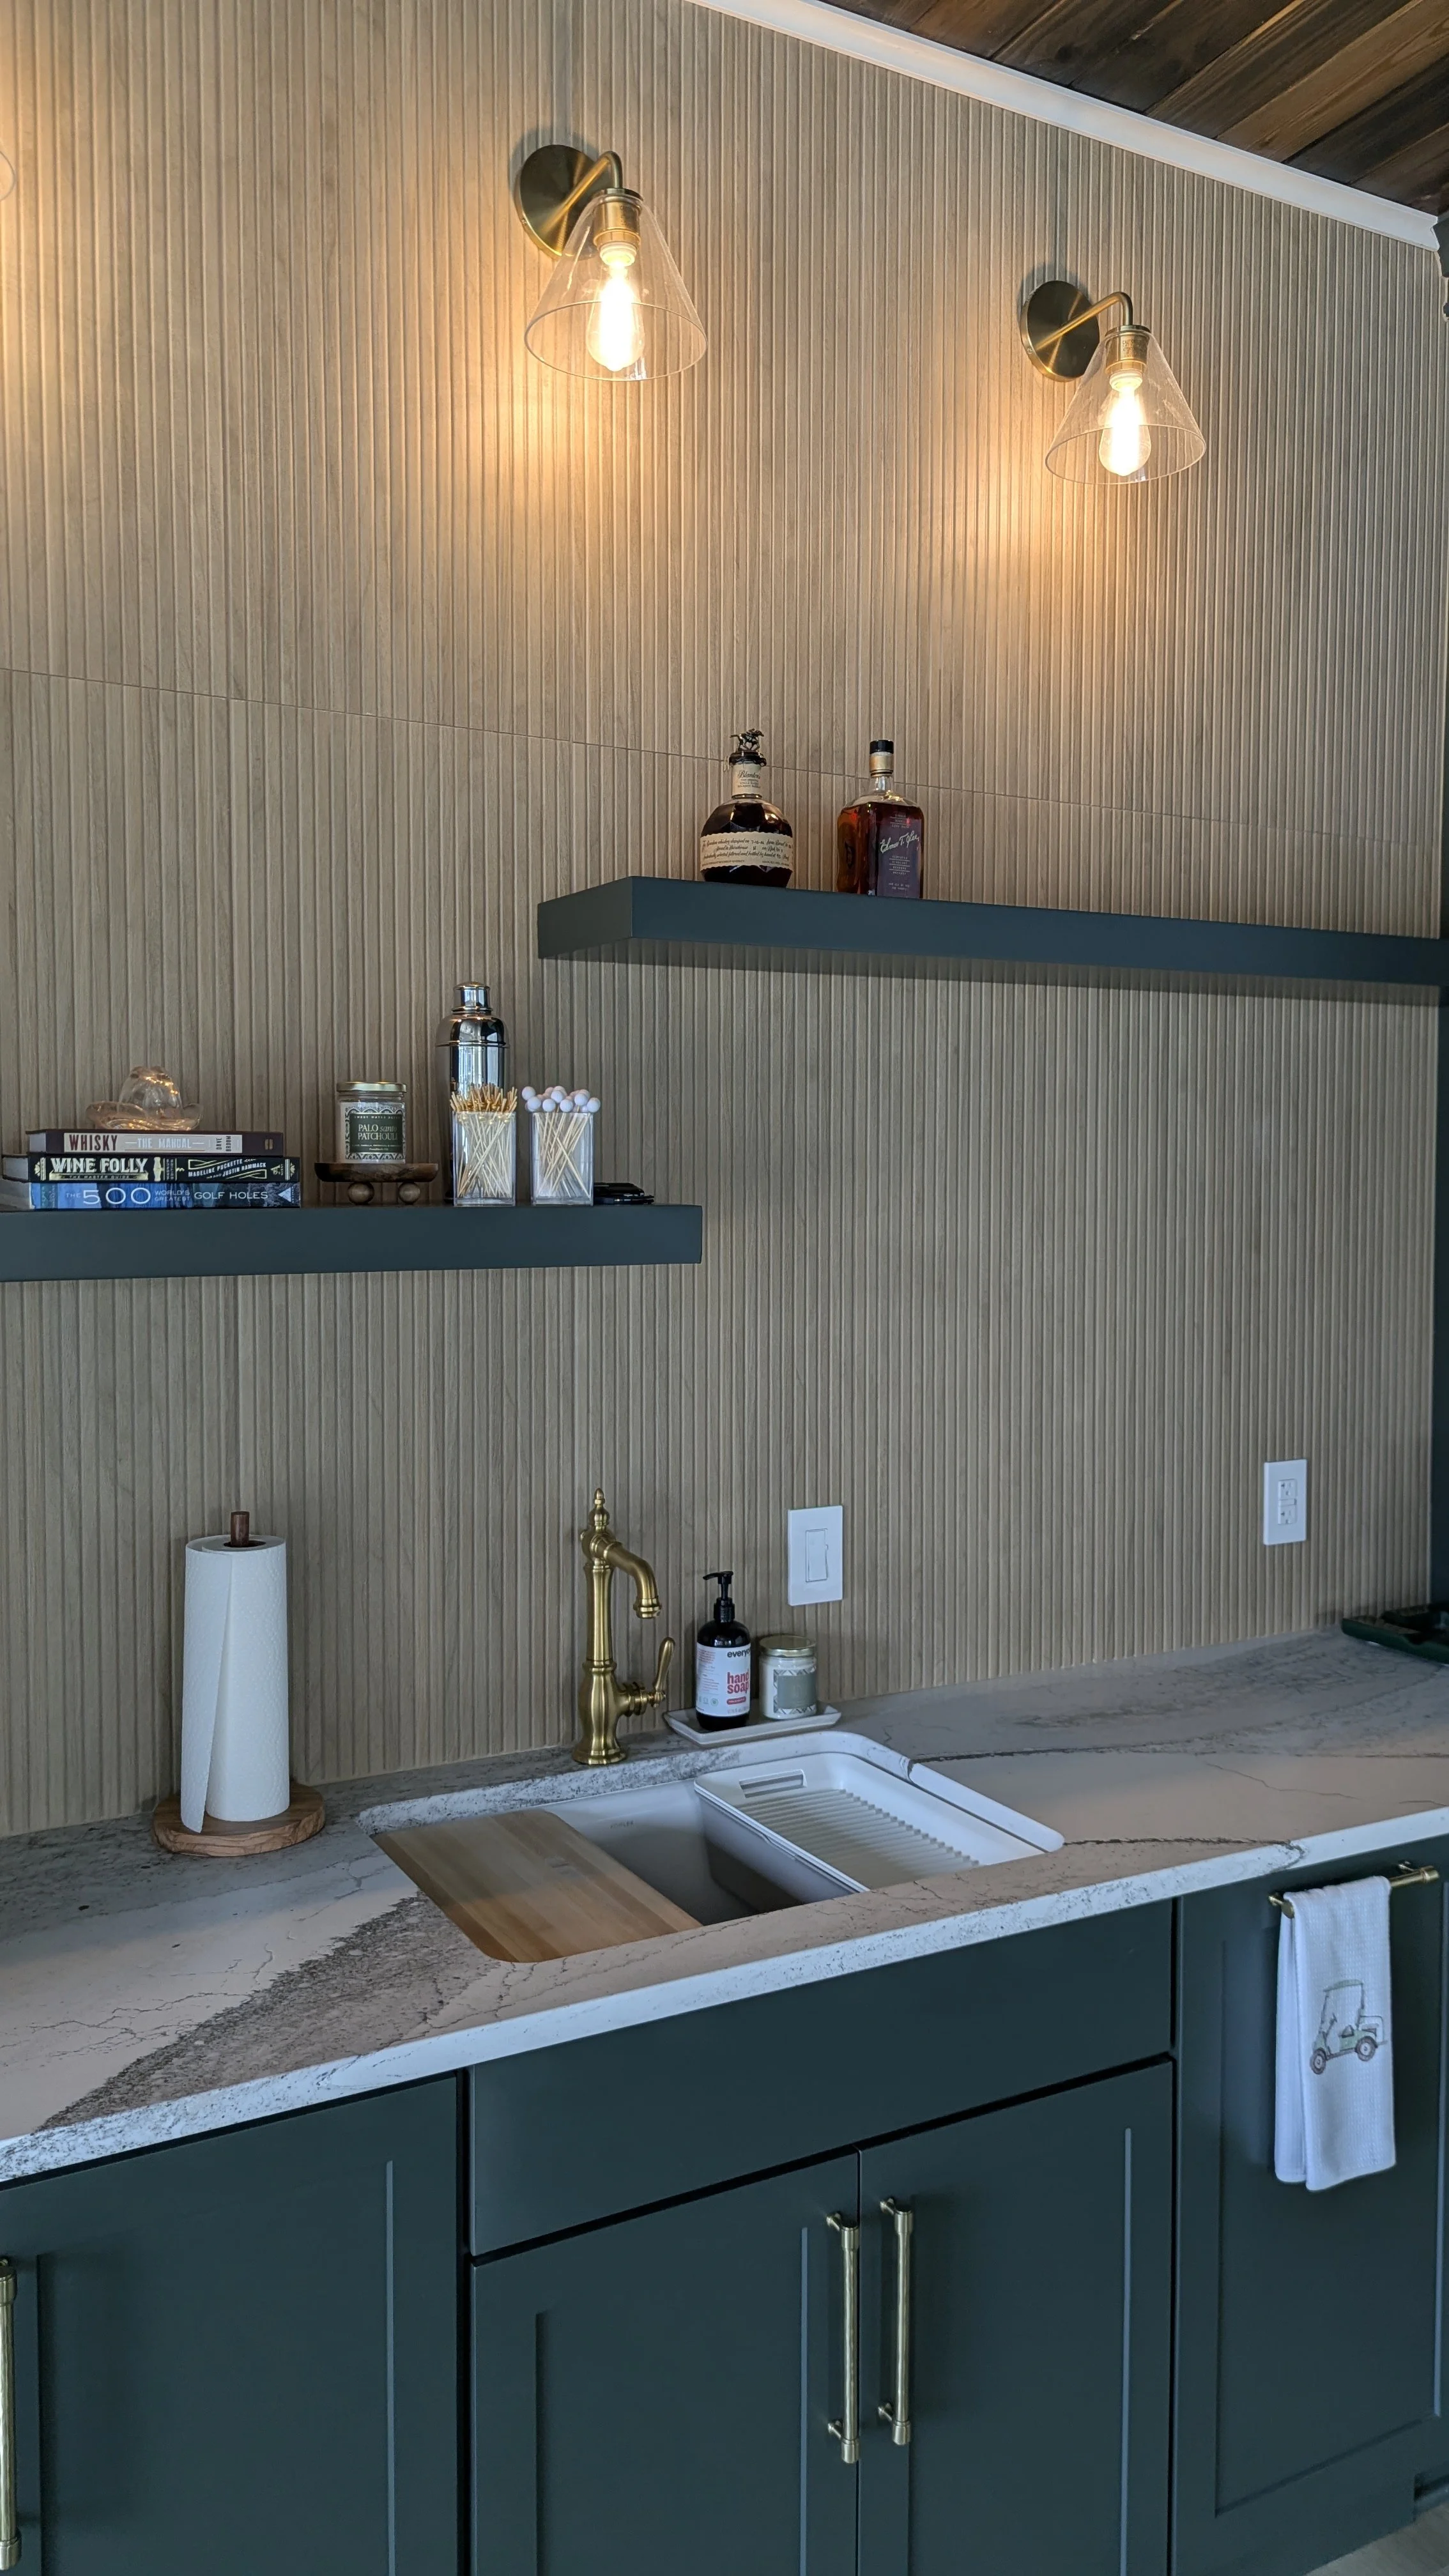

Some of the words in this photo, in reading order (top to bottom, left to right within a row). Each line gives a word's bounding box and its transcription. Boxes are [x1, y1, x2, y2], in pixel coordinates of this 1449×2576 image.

[358, 1124, 379, 1132] PALO
[69, 1135, 118, 1151] WHISKY
[137, 1138, 153, 1148] THE
[158, 1138, 192, 1148] MANUAL
[358, 1132, 398, 1140] PATCHOULI
[50, 1158, 97, 1173] WINE
[100, 1158, 148, 1173] FOLLY
[188, 1167, 215, 1177] MADELINE
[217, 1158, 243, 1171] PUCKETTE
[222, 1167, 240, 1177] JUSTIN
[83, 1187, 151, 1204] 500
[727, 1668, 749, 1685] hand
[727, 1681, 749, 1695] soap
